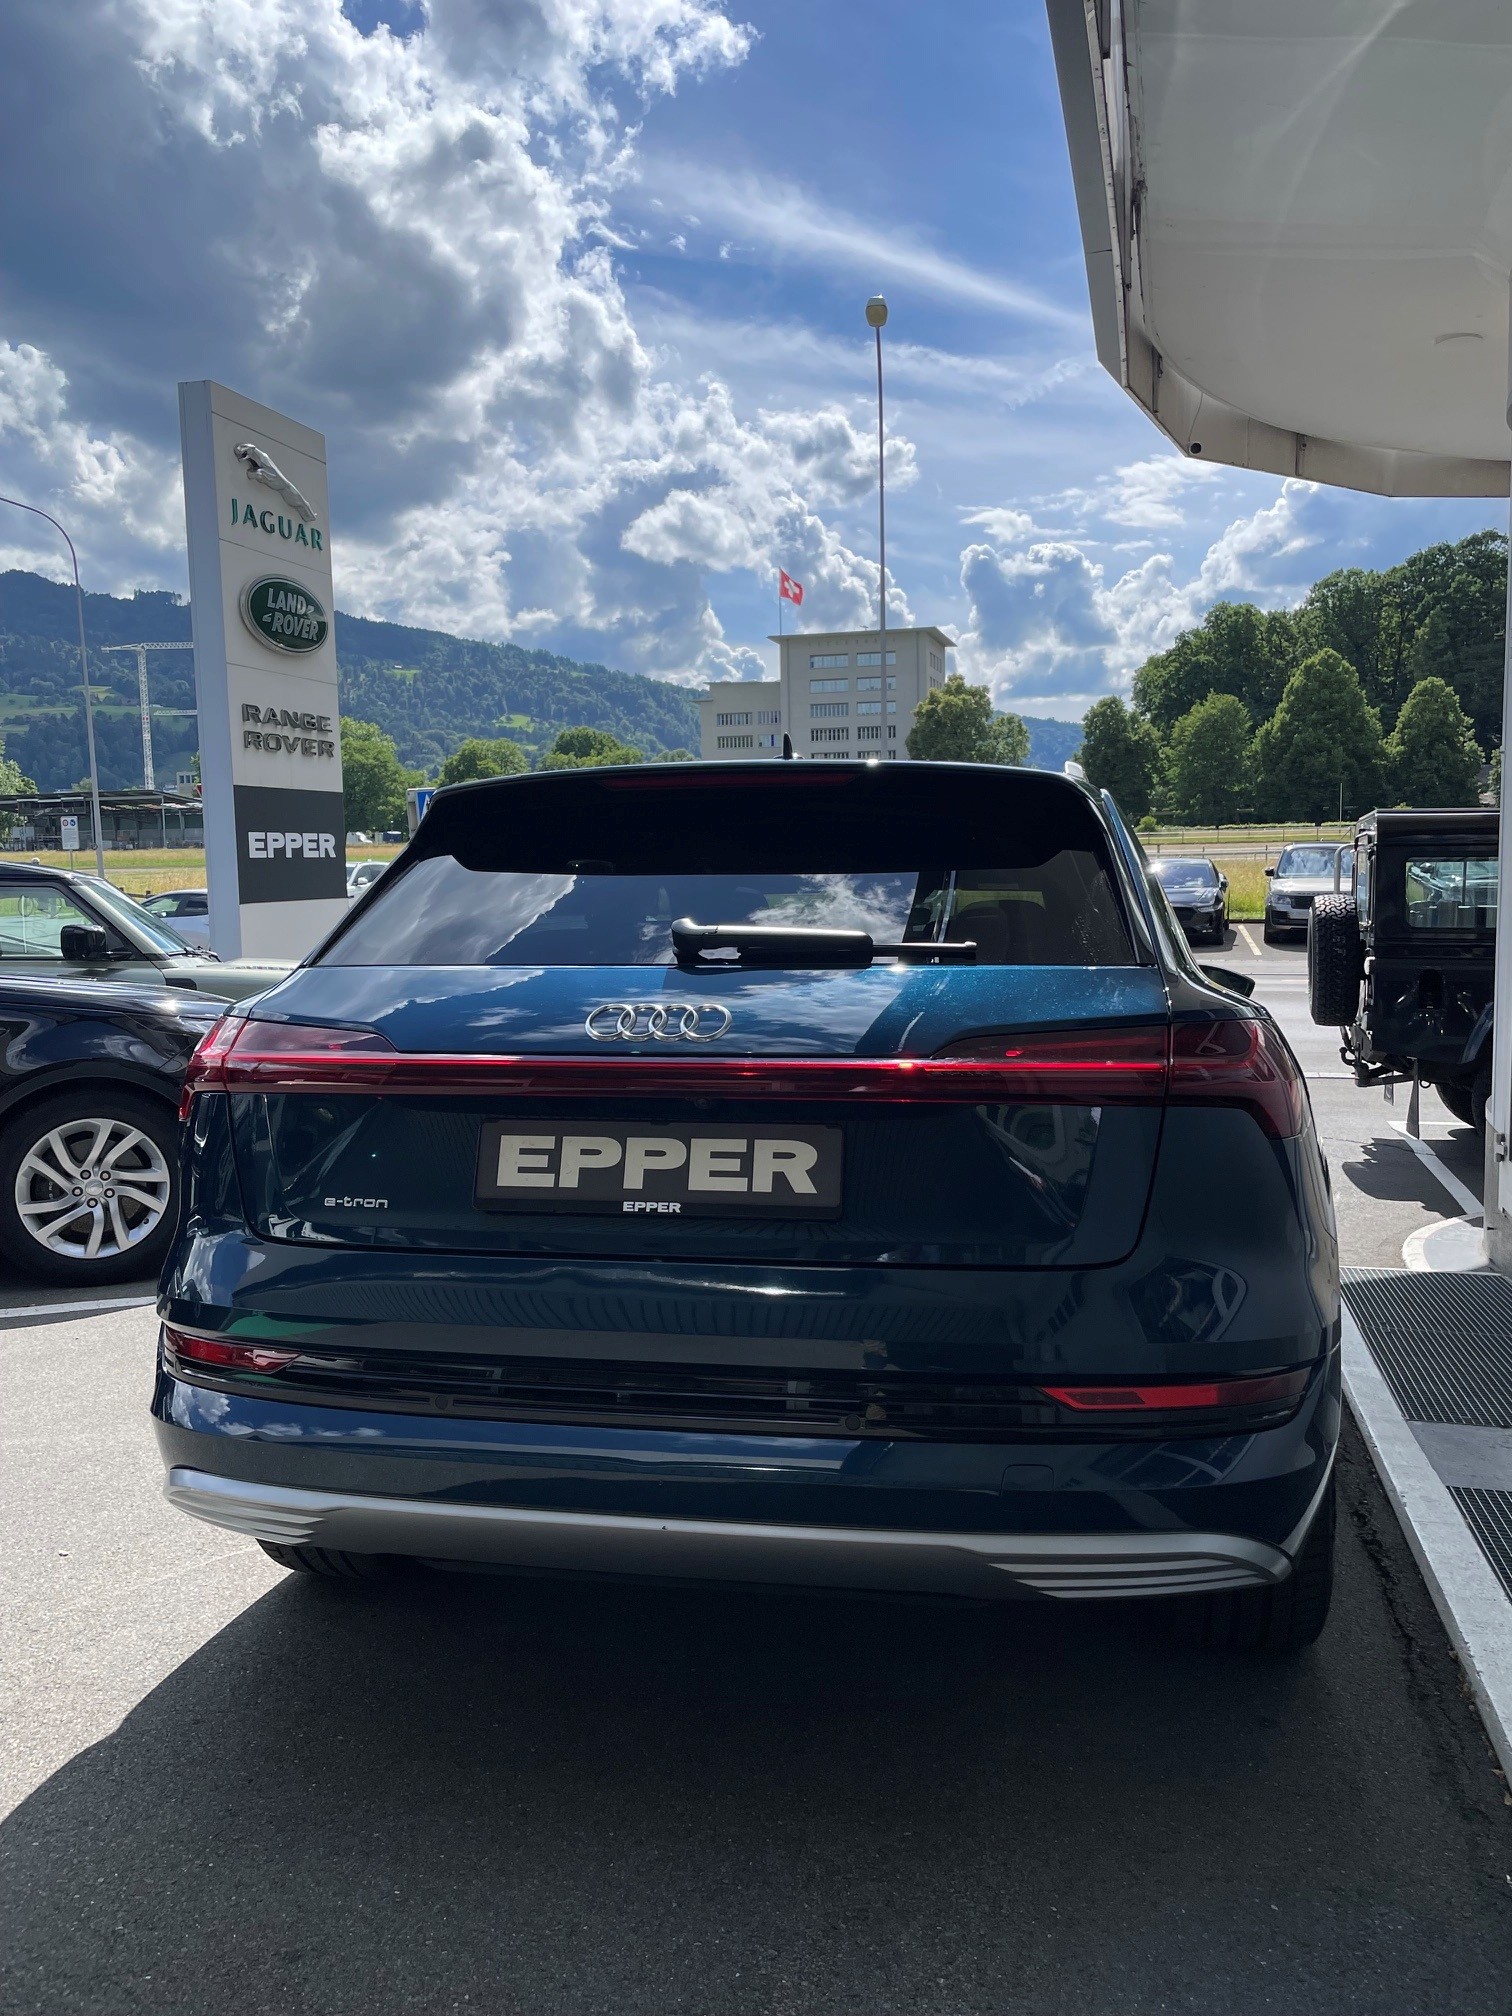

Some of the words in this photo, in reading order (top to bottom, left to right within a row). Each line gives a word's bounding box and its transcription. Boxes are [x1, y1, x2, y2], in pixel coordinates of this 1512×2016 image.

[231, 498, 323, 550] JAGUAR
[267, 588, 306, 615] LAND
[271, 612, 319, 641] ROVER
[242, 703, 333, 733] RANGE
[243, 731, 335, 758] ROVER
[248, 831, 336, 859] EPPER
[496, 1134, 818, 1194] EPPER
[324, 1196, 388, 1208] e-tron
[622, 1201, 681, 1214] EPPER
